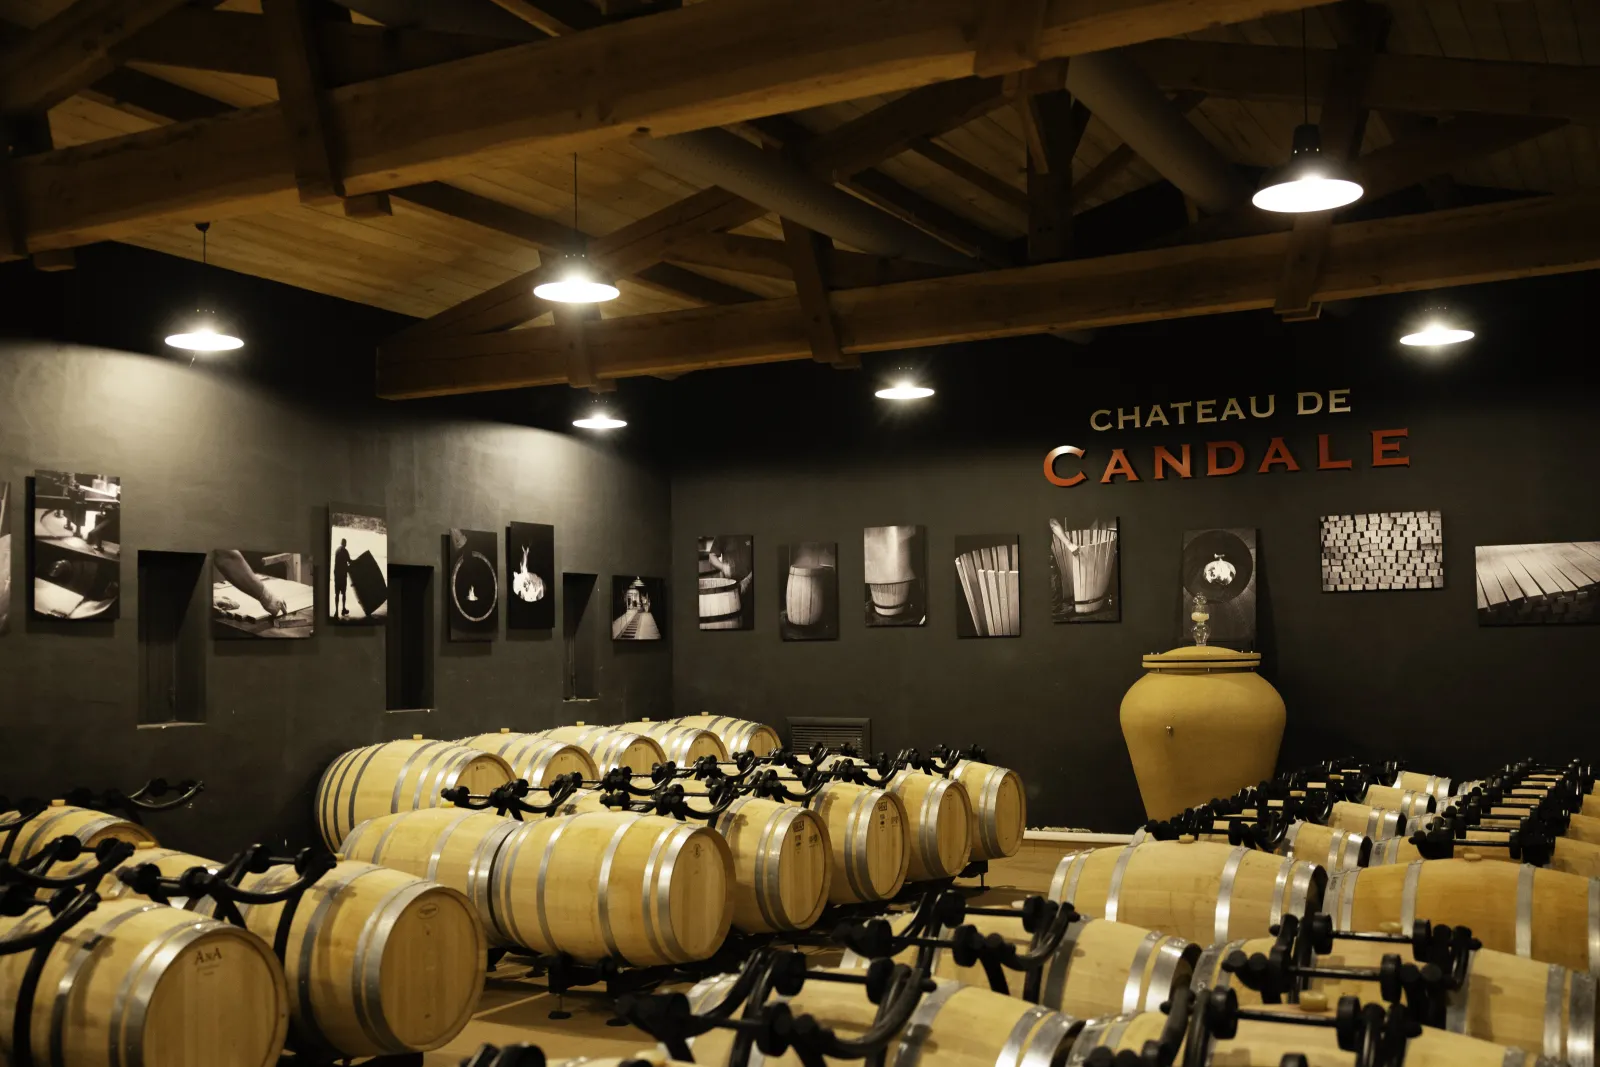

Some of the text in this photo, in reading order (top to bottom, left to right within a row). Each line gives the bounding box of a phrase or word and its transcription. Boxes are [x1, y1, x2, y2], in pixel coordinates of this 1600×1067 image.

[1090, 388, 1352, 432] CHATEAU DE
[1043, 428, 1410, 487] CANDALE
